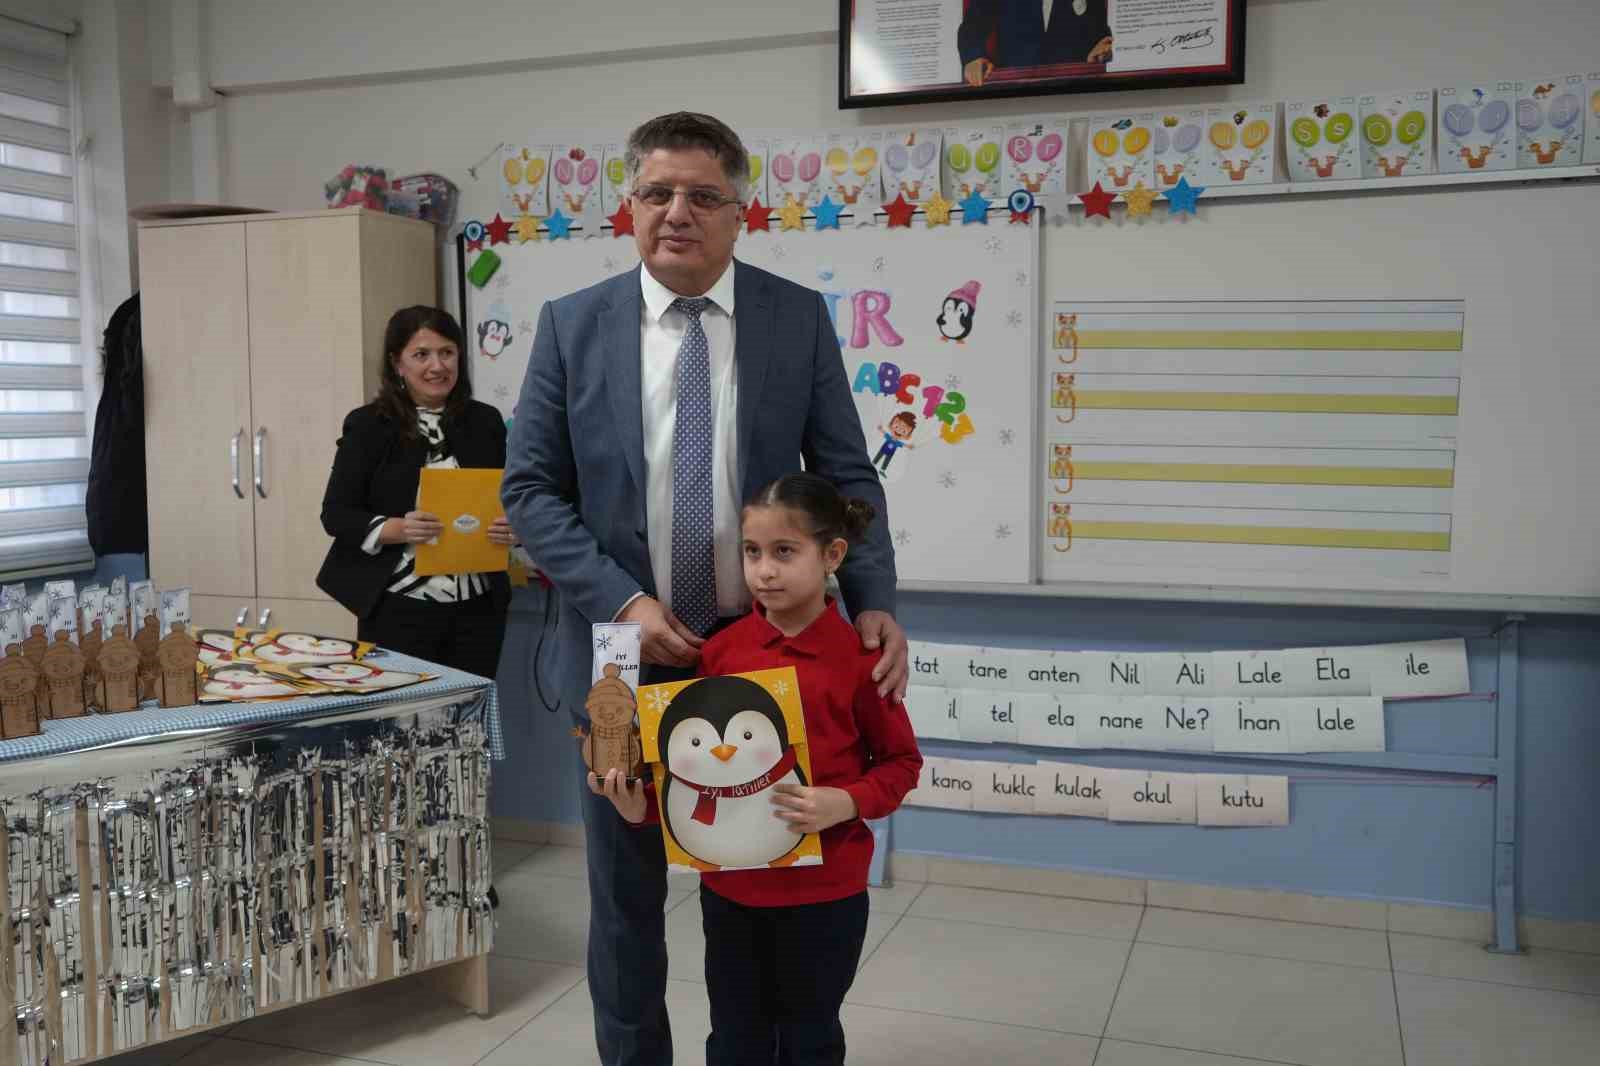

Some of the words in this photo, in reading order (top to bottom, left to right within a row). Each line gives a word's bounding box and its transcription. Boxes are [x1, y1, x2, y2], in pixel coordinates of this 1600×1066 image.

[913, 655, 939, 675] tat
[968, 659, 1008, 680] tane
[1028, 665, 1080, 684] anten
[1110, 662, 1141, 685] Nil
[1176, 662, 1205, 685] Ali
[1237, 661, 1283, 684] Lale
[1315, 657, 1351, 681] Ela
[1405, 652, 1430, 676] ile
[947, 698, 958, 720] il
[991, 702, 1014, 724] tel
[1047, 705, 1075, 727] ela
[1099, 714, 1144, 730] nane
[1165, 707, 1210, 730] Ne?
[1238, 700, 1281, 731] İnan
[1317, 707, 1356, 731] lale
[931, 768, 973, 792] kano
[1055, 773, 1102, 799] kulak
[1133, 782, 1172, 805] okul
[1222, 784, 1264, 808] kutu
